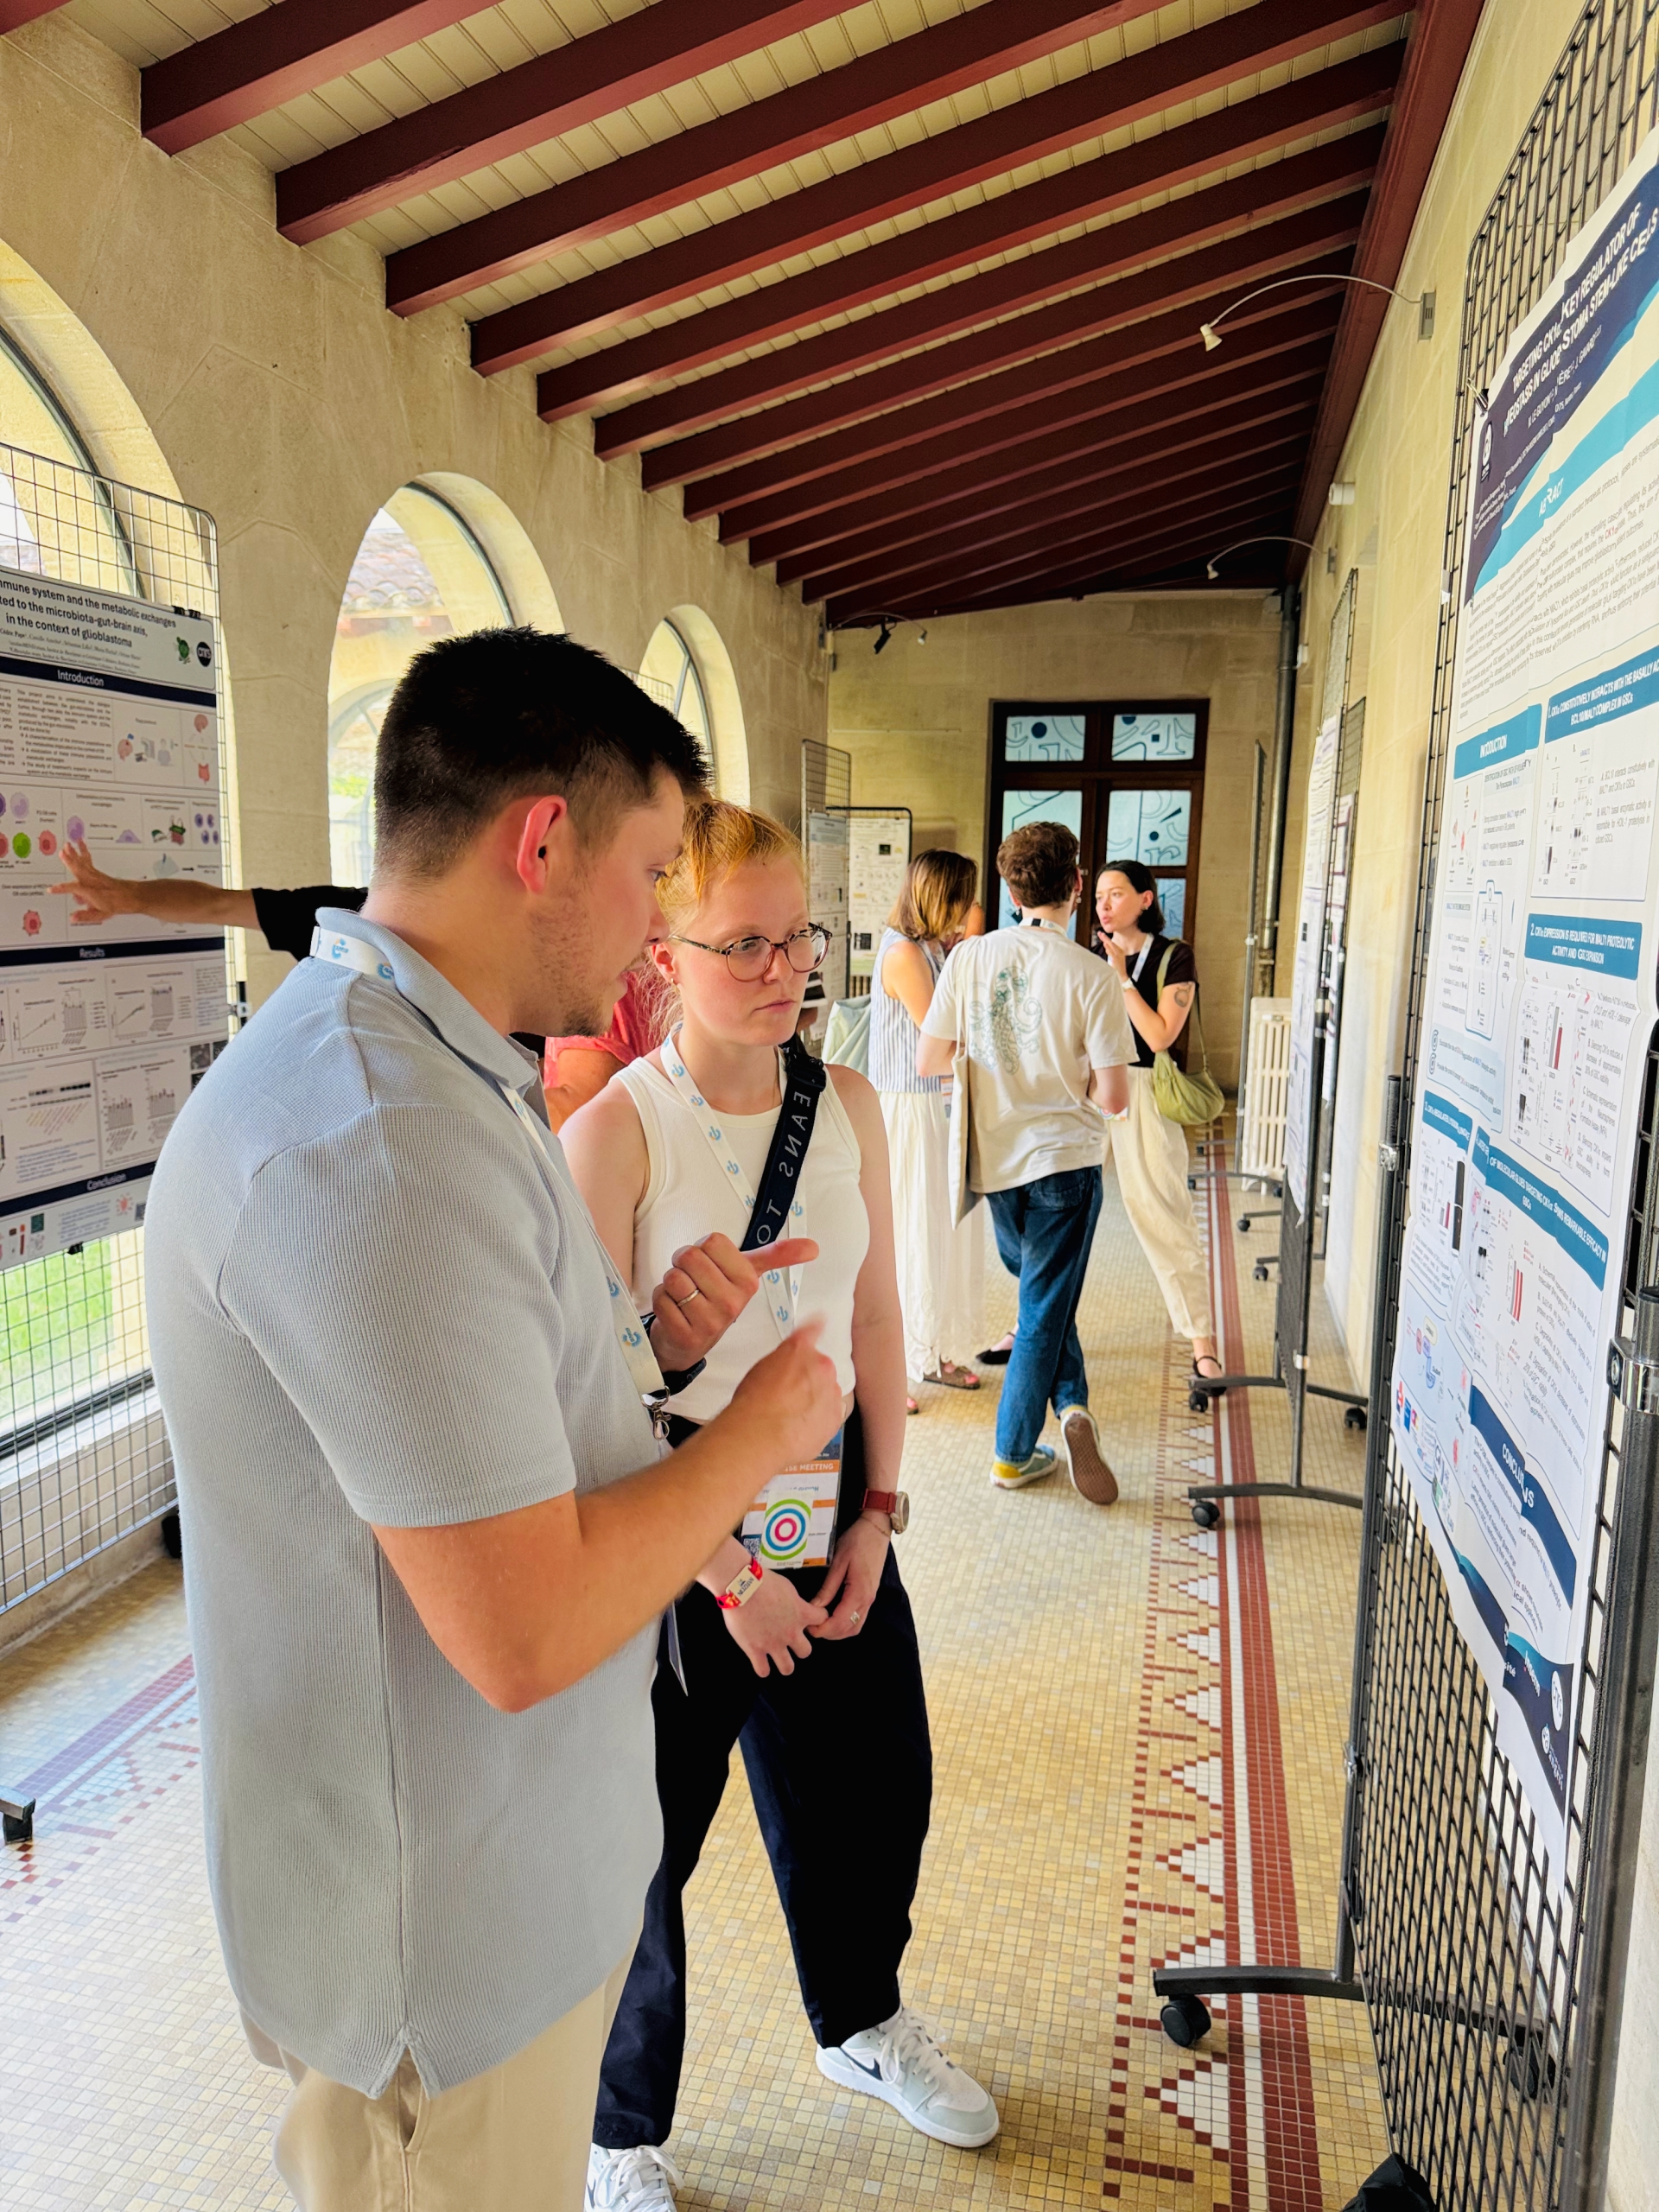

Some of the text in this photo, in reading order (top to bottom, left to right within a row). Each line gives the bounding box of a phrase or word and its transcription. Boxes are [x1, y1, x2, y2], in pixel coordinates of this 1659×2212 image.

[1513, 340, 1542, 394] TARGETING
[1562, 287, 1580, 320] KEY
[1580, 224, 1627, 302] REGULATOR
[1627, 202, 1641, 237] OF
[1533, 369, 1541, 392] IN
[1590, 247, 1630, 317] STEM-LIKE
[0, 578, 176, 629] mmune system and the metabolic exchanges
[0, 595, 148, 638] ted to the microbiota-gut-brain axis,
[6, 613, 15, 624] in
[17, 615, 34, 628] the
[35, 619, 70, 636] context
[71, 625, 80, 638] of
[81, 628, 132, 648] glioblastoma
[57, 669, 105, 688] Introduction
[1480, 734, 1507, 759] INTODUCTION
[79, 947, 105, 959] Results
[1490, 1156, 1497, 1167] OF
[86, 1172, 127, 1192] Conclusion
[799, 1463, 834, 1471] MEETING
[1502, 1443, 1535, 1508] CONCLUSNS
